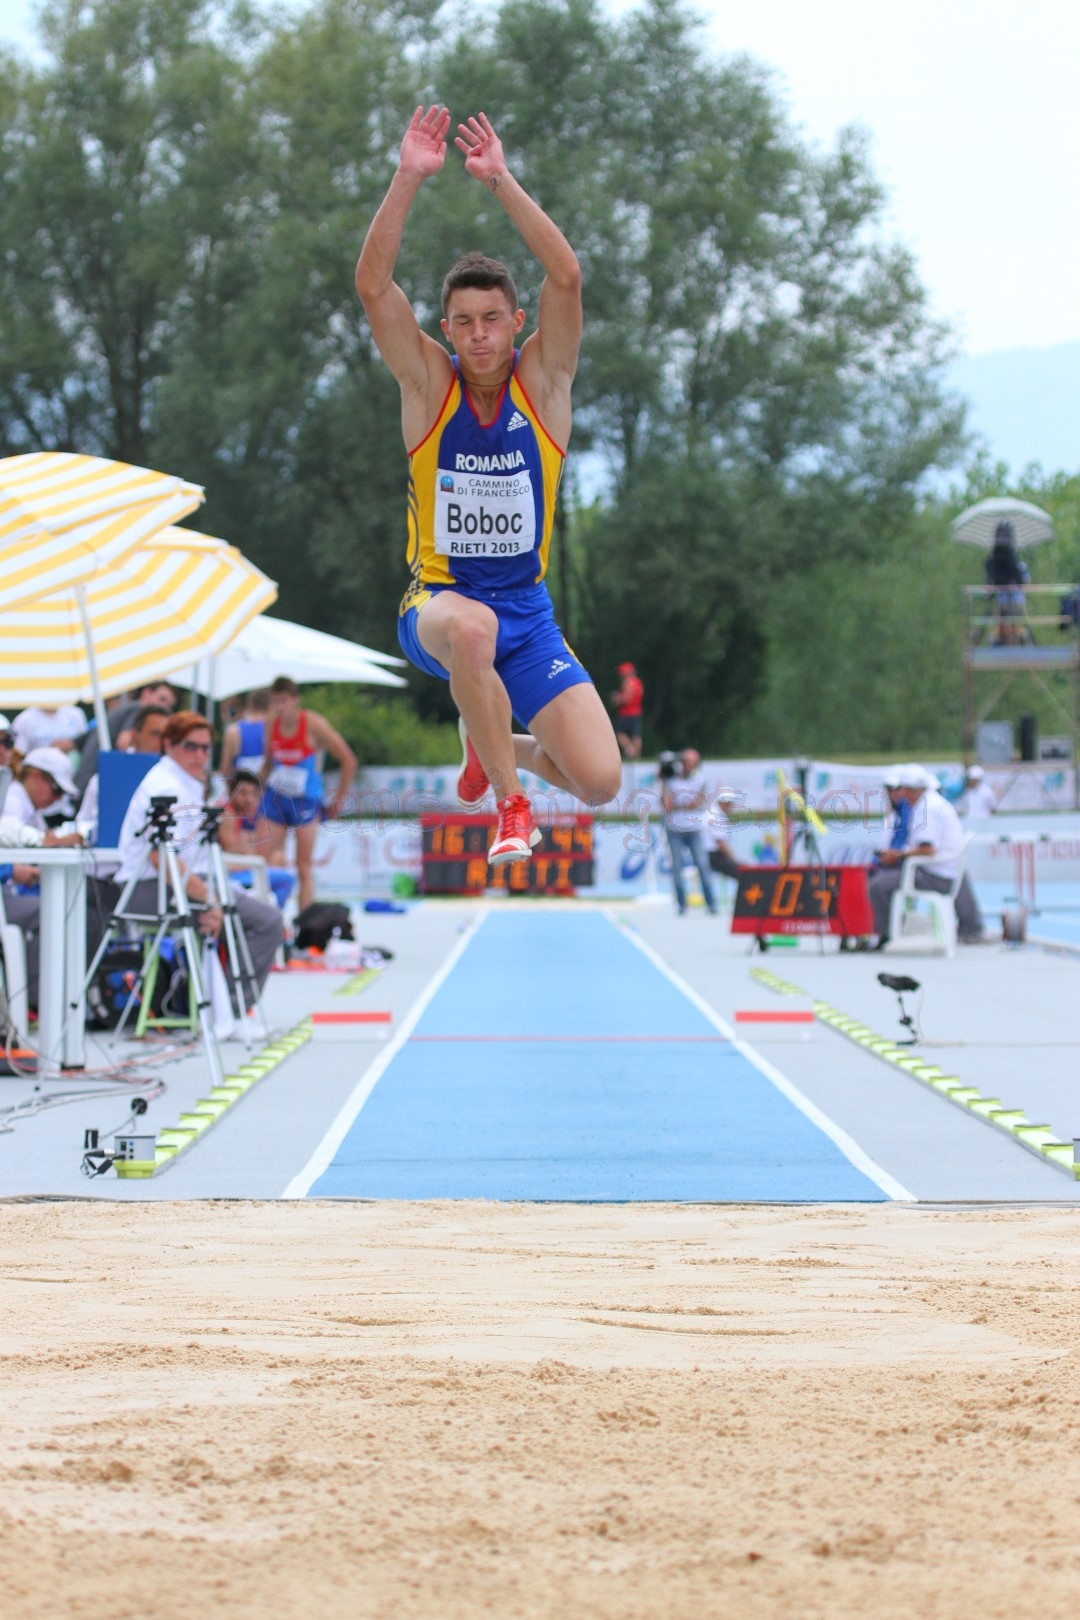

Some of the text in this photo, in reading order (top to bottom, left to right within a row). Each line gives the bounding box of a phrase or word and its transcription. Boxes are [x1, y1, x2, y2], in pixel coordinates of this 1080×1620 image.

[507, 419, 528, 432] adidas
[455, 450, 526, 472] ROMANIA
[468, 478, 520, 489] CAMMINO
[457, 484, 530, 498] DI FRANCESCO
[447, 502, 523, 535] Boboc
[450, 541, 520, 554] RIETI 2013
